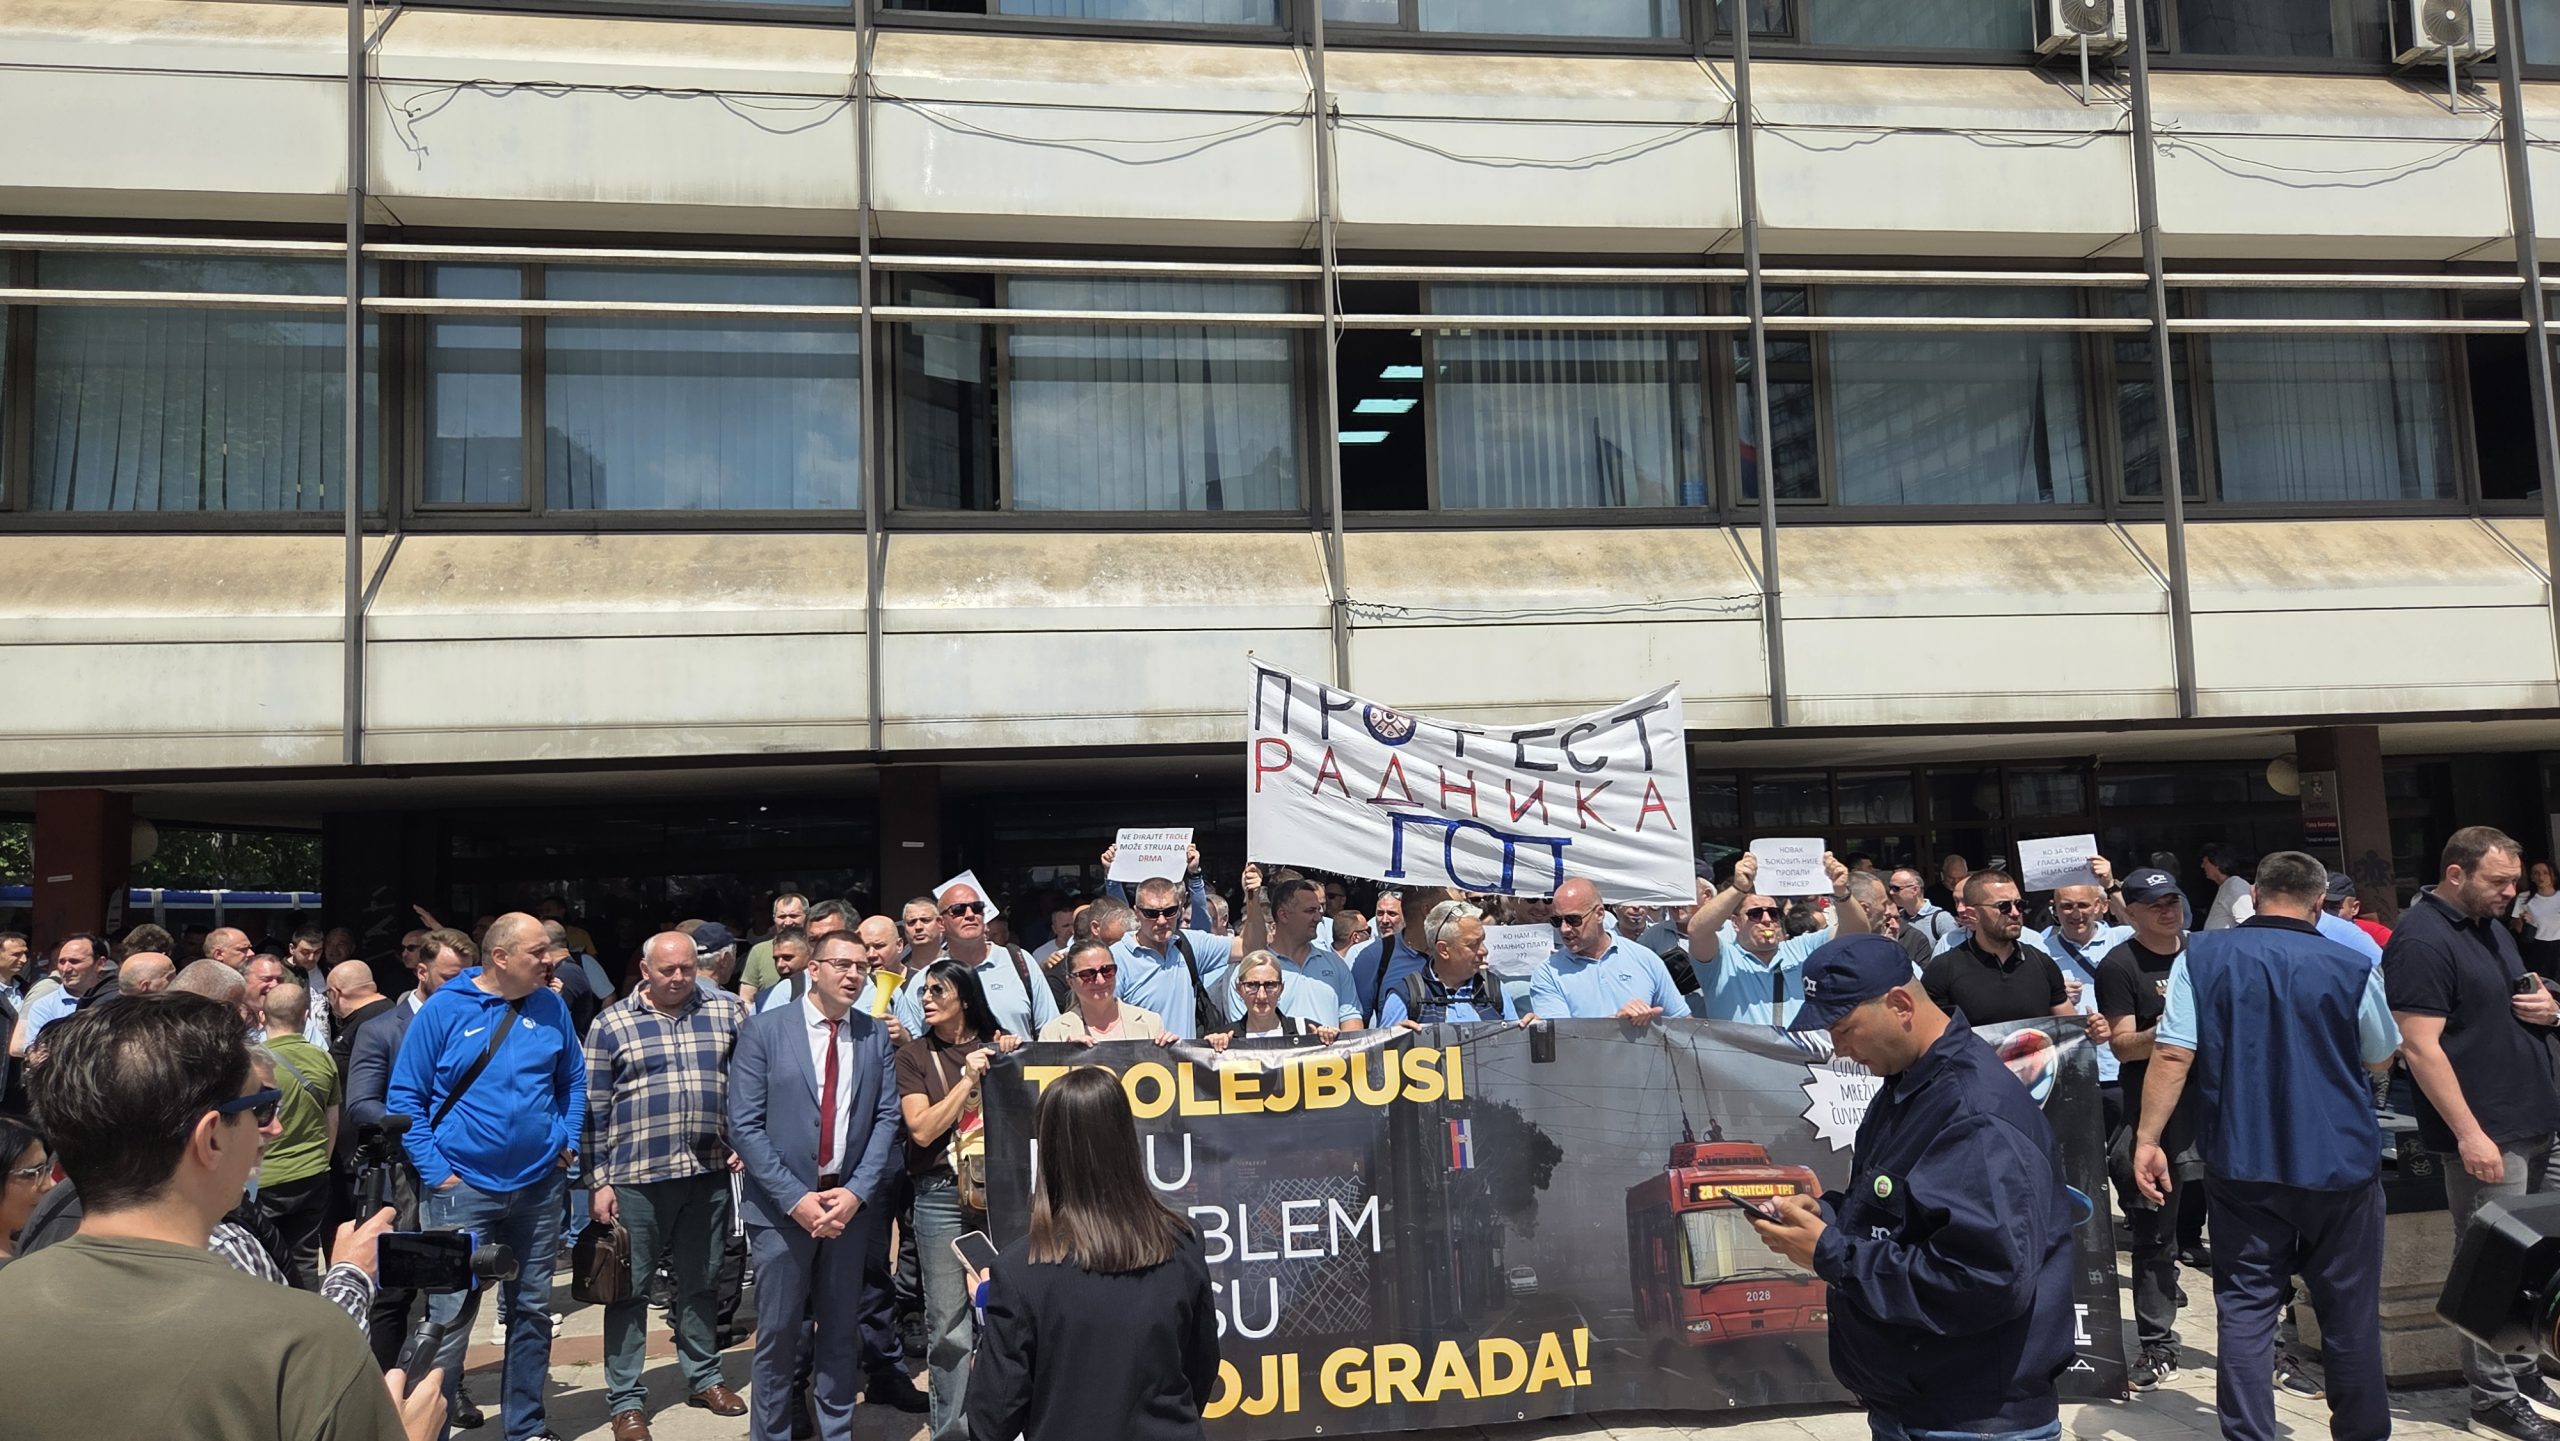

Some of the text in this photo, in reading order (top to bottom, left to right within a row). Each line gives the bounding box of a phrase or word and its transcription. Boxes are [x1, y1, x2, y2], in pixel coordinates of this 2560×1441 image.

[1255, 738, 1677, 832] РАДНИКА
[1143, 843, 1172, 851] STRUJA
[1384, 812, 1572, 898] ГСП
[1502, 932, 1513, 940] КО
[1526, 940, 1549, 949] ПЛАТУ
[1023, 1045, 1464, 1119] TOLEJBUSI
[1698, 1184, 1714, 1201] 28
[1187, 1195, 1382, 1264] BLEM
[1745, 1290, 1771, 1302] 2028
[1319, 1327, 1593, 1408] GRADA!
